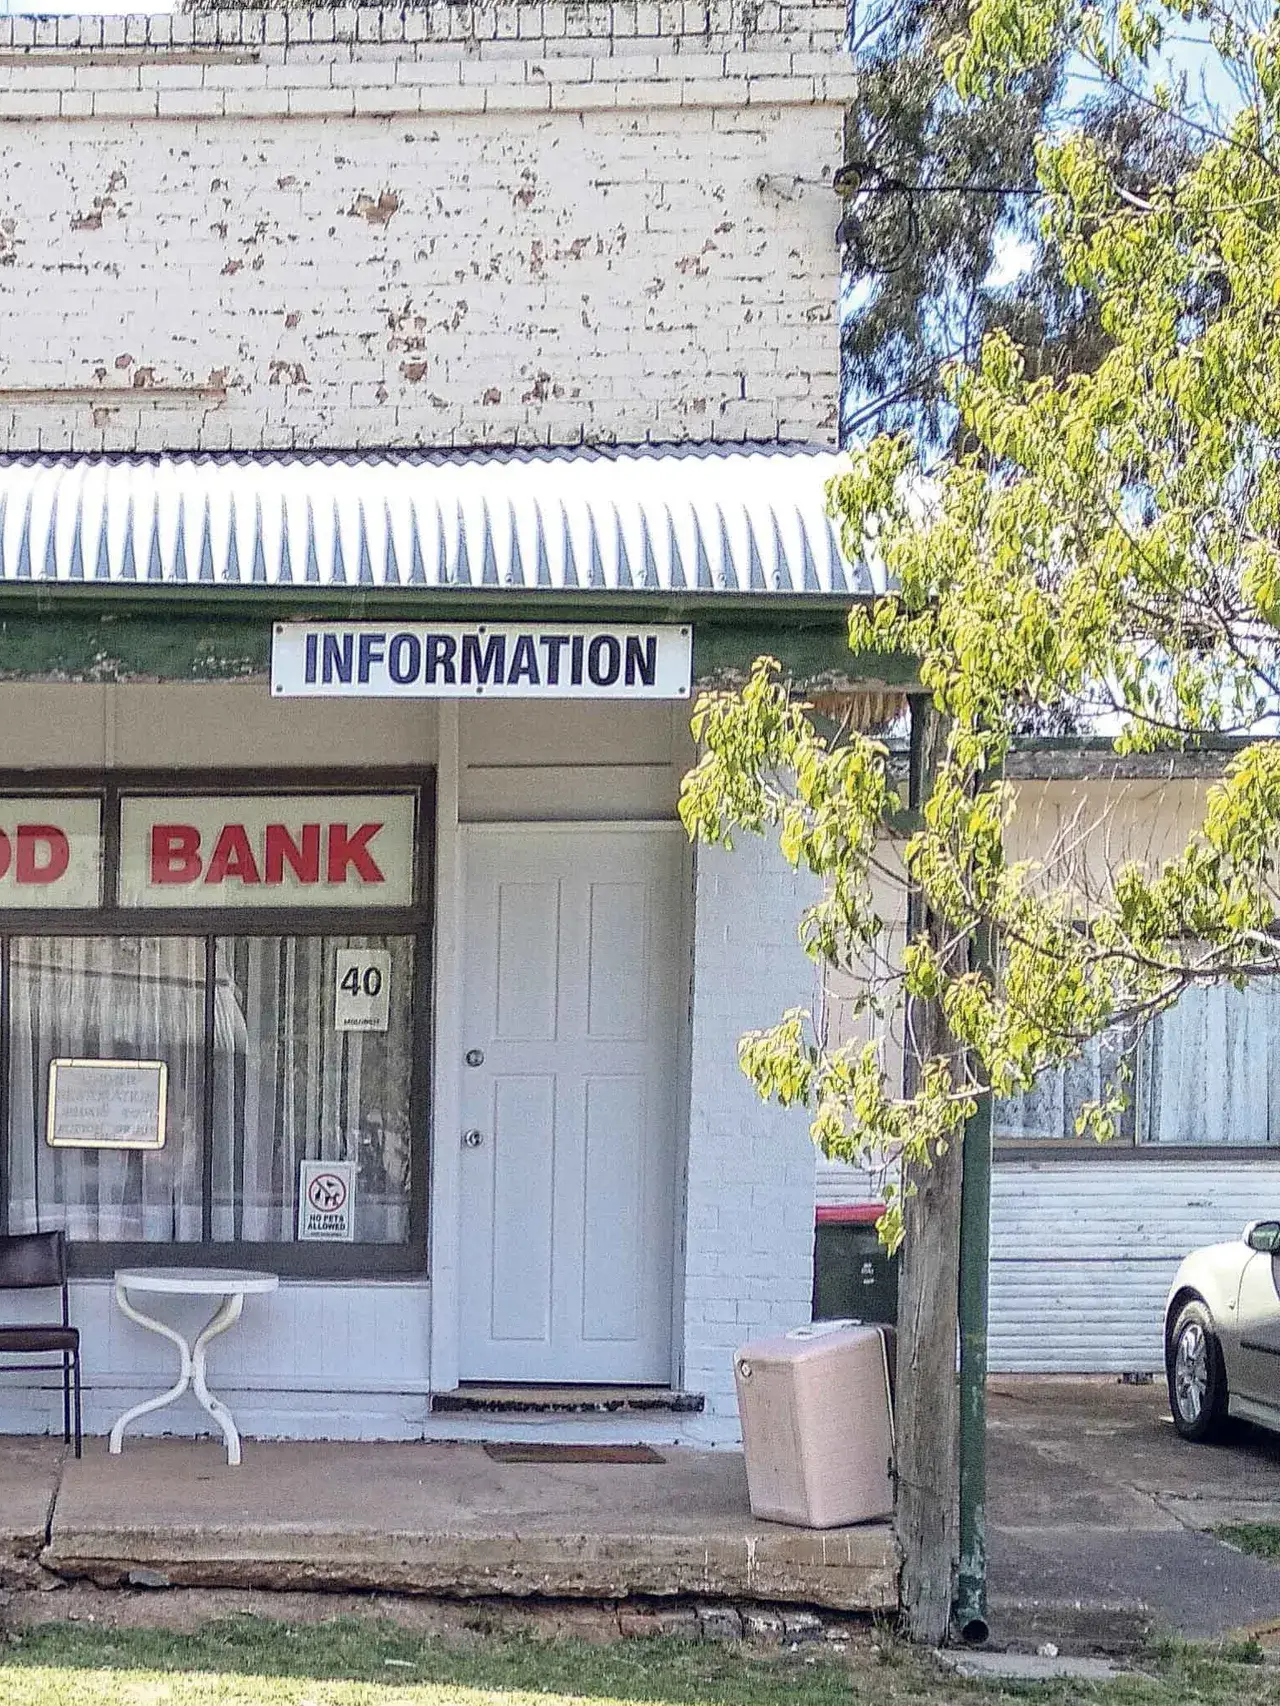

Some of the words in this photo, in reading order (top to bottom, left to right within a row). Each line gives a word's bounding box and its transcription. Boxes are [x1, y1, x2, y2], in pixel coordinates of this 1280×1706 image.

[304, 632, 657, 686] INFORMATION
[150, 822, 386, 886] BANK
[340, 966, 382, 996] 40
[307, 1222, 346, 1231] ALLOWED
[310, 1214, 322, 1222] NO
